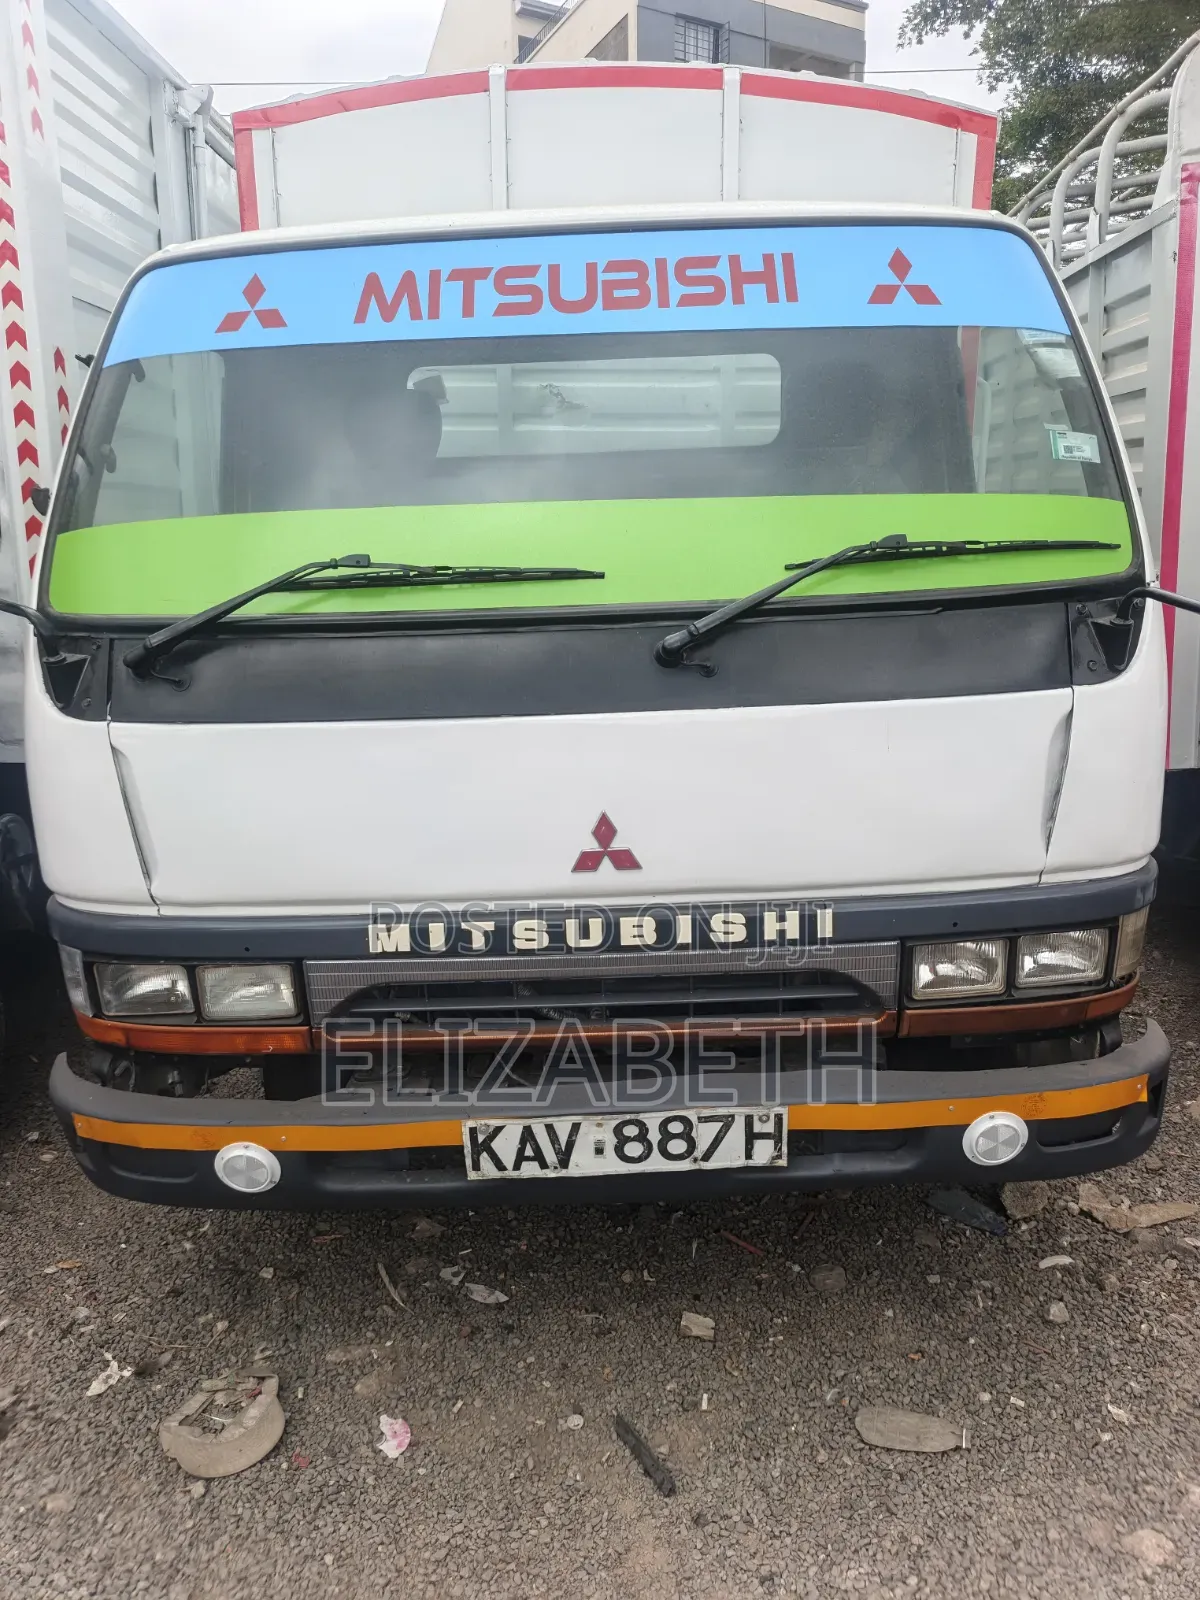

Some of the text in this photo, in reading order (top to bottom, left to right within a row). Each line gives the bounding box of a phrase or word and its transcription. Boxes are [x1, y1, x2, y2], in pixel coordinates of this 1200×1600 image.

[353, 252, 799, 325] MITSUBISHI
[367, 908, 834, 953] MITSUBISHI
[469, 1112, 785, 1173] KAV 887H
